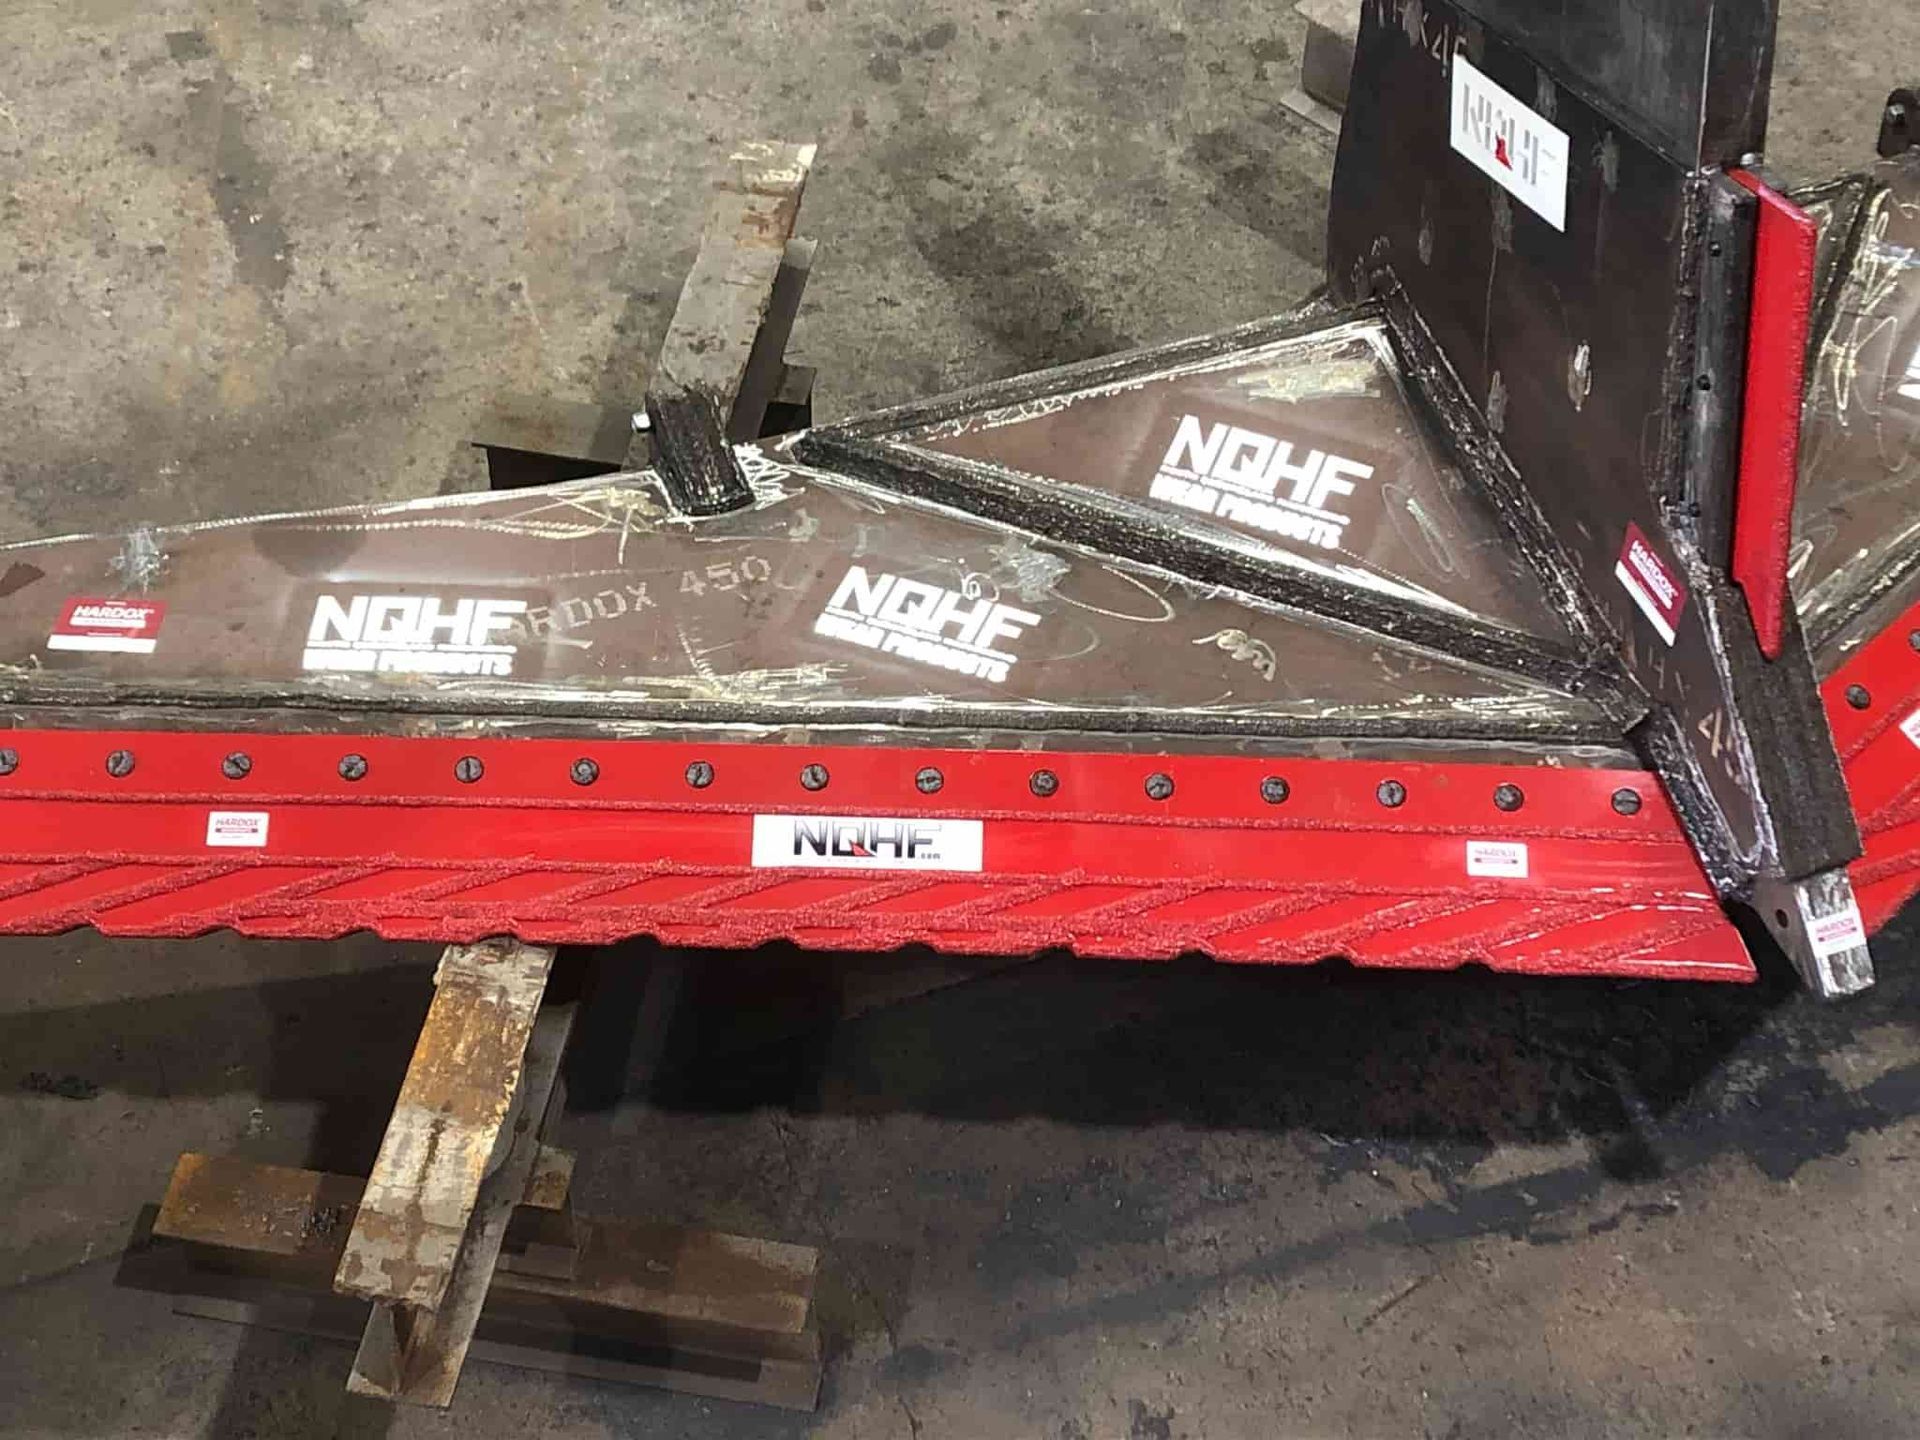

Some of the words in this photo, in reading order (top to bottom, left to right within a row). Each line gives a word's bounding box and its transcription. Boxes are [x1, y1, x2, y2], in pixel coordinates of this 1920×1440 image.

[1162, 414, 1374, 508] NQHF
[680, 555, 771, 596] 450
[1630, 540, 1676, 600] HARDOX
[73, 605, 146, 620] HARDOX
[307, 595, 527, 645] NQHF
[828, 566, 1042, 650] NQHF
[794, 821, 941, 859] NQHF
